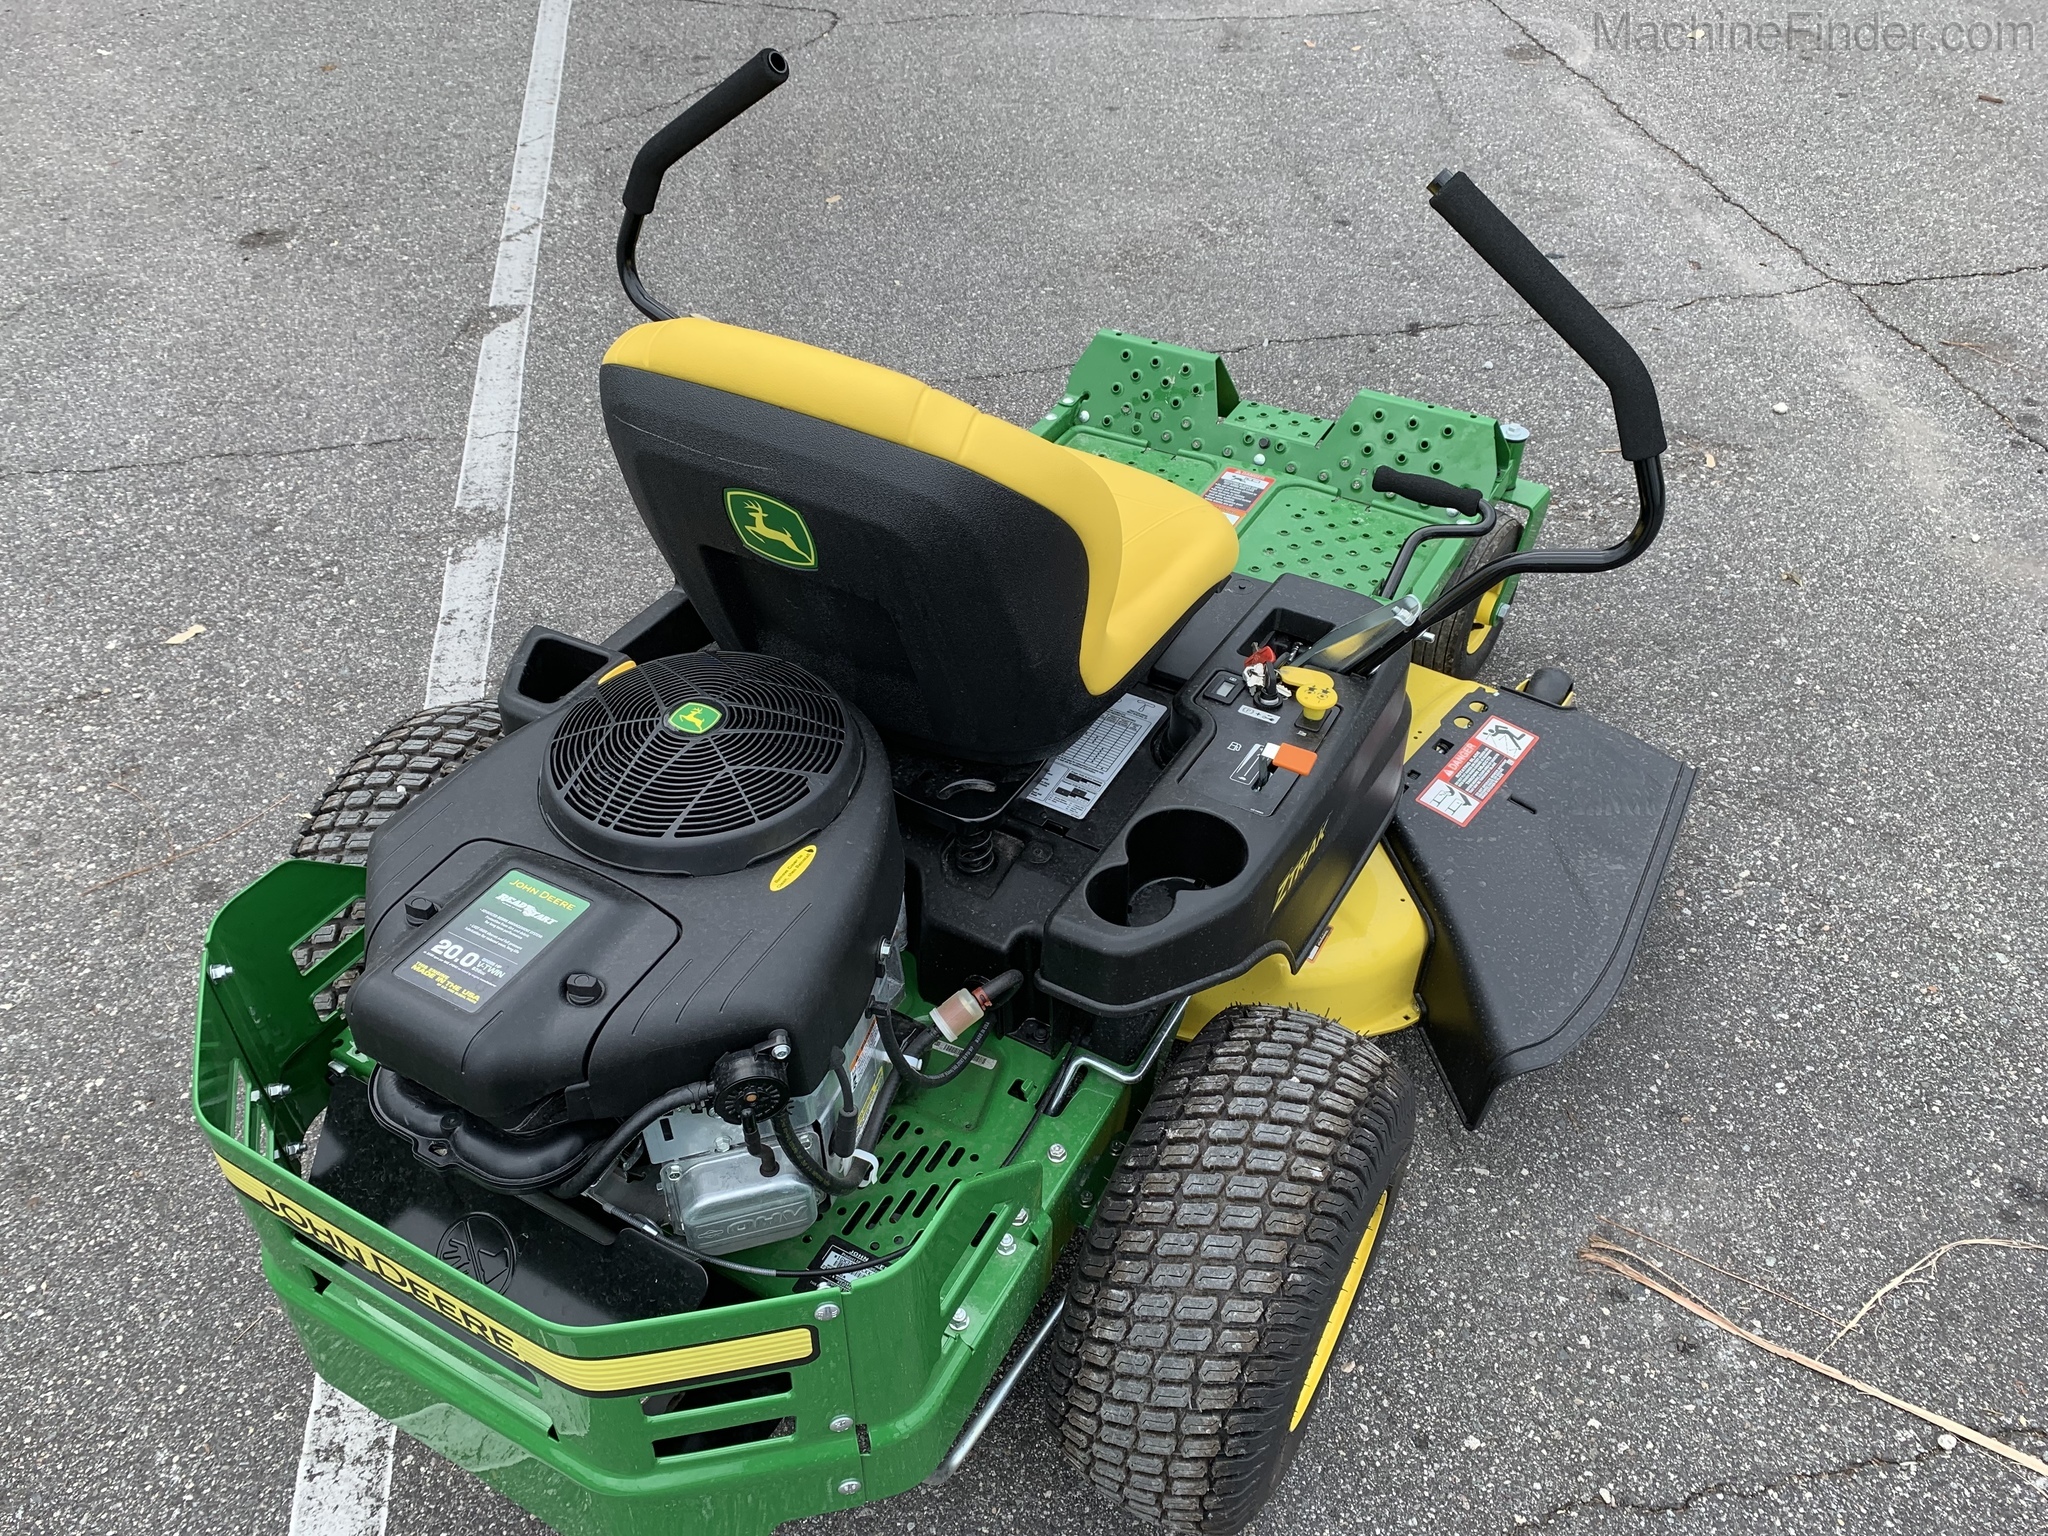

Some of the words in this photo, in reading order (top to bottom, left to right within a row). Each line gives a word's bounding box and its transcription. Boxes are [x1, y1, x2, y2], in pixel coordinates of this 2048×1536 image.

[1448, 742, 1477, 771] DANGER
[509, 879, 540, 895] JOHN
[539, 890, 577, 911] DEERE
[430, 939, 480, 968] 20.0
[411, 963, 436, 980] MADE
[435, 973, 446, 984] IN
[445, 980, 462, 992] THE
[461, 989, 480, 1002] USA
[476, 961, 506, 978] V-TWIN
[727, 1205, 808, 1235] OHV
[850, 1249, 869, 1262] JOHN
[261, 1190, 367, 1267] JOHN
[371, 1253, 519, 1357] DEERE
